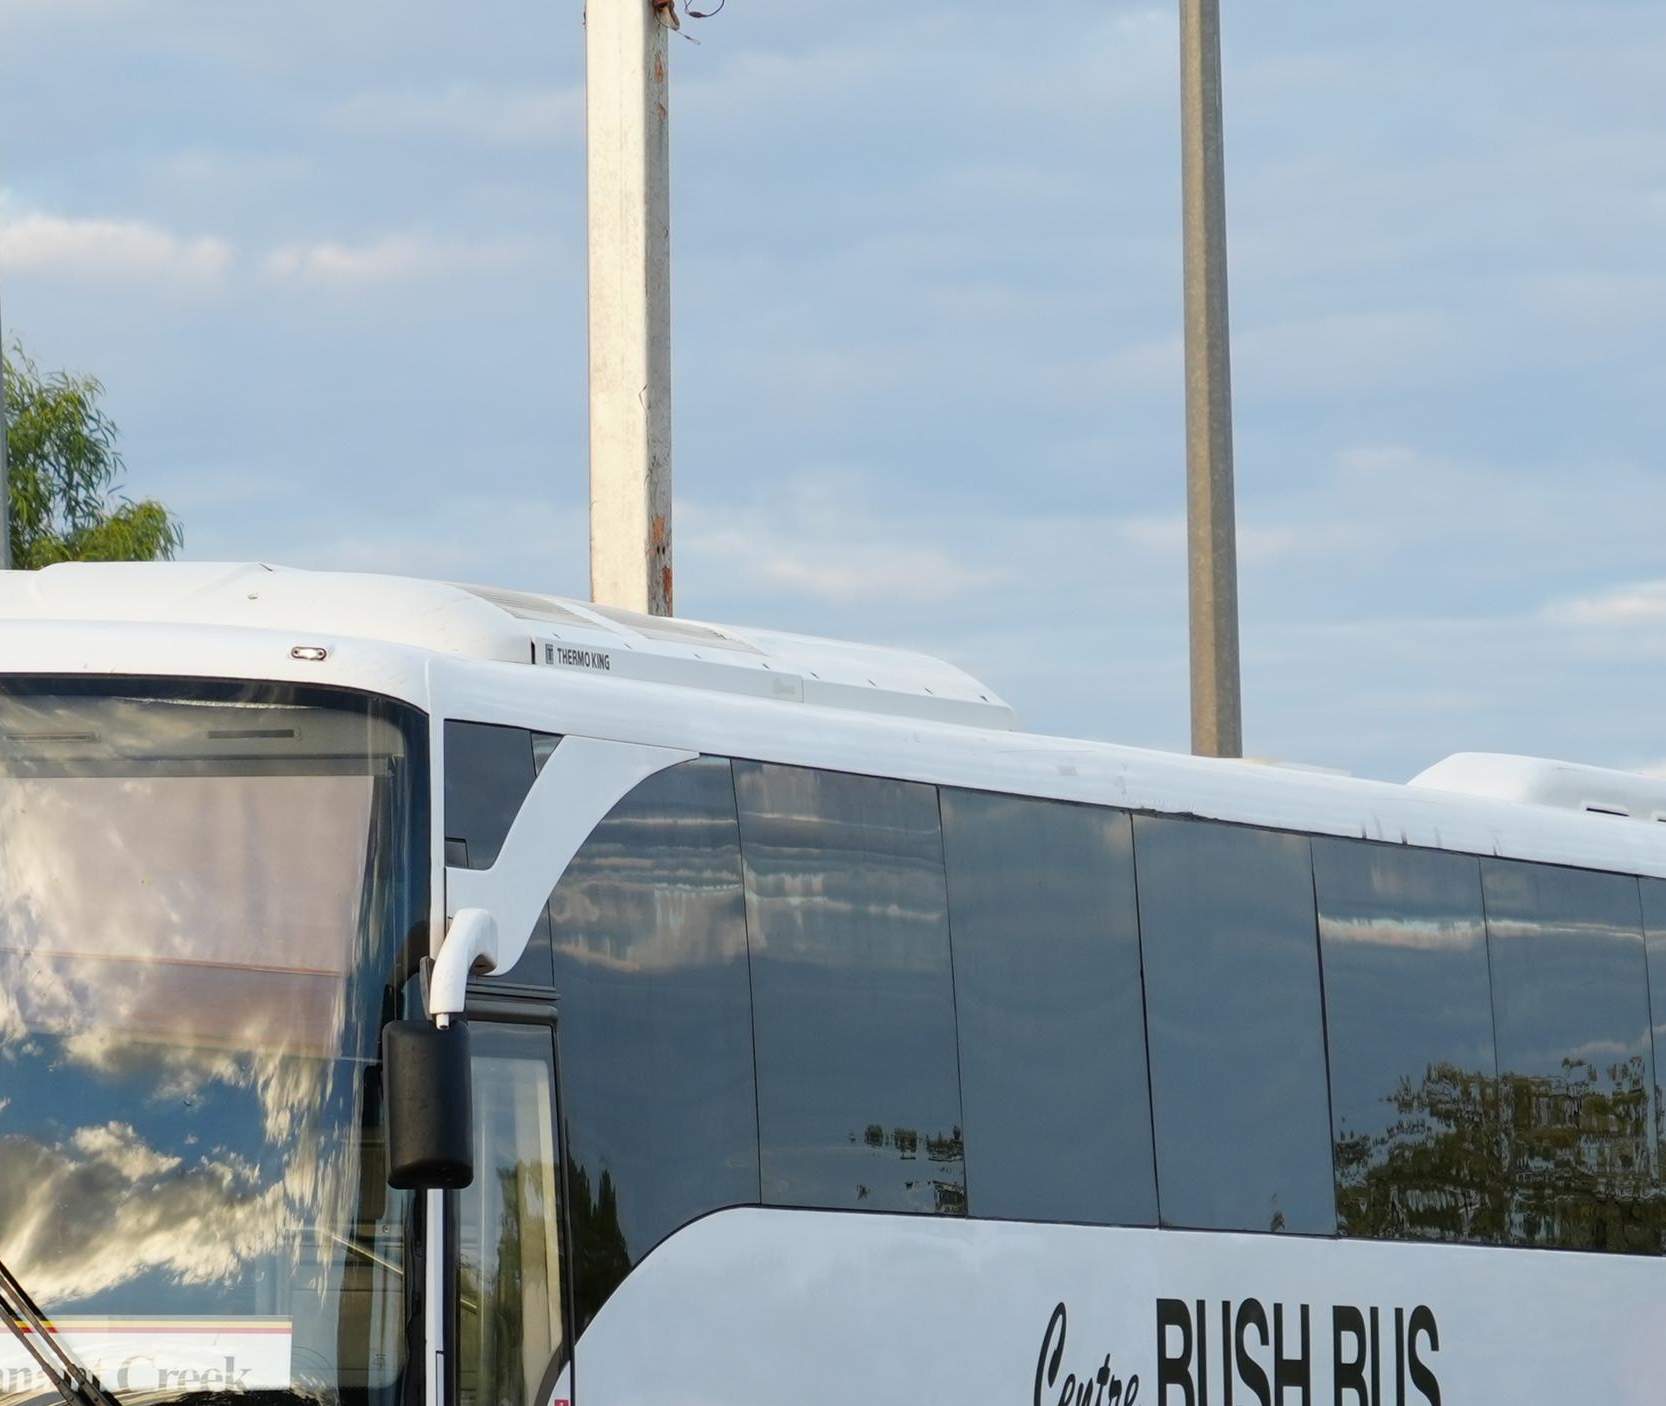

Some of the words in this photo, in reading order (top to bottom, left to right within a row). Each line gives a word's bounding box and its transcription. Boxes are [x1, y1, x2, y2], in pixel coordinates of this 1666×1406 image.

[557, 648, 590, 667] THERMO
[591, 652, 610, 670] KING
[117, 1354, 253, 1393] Creek
